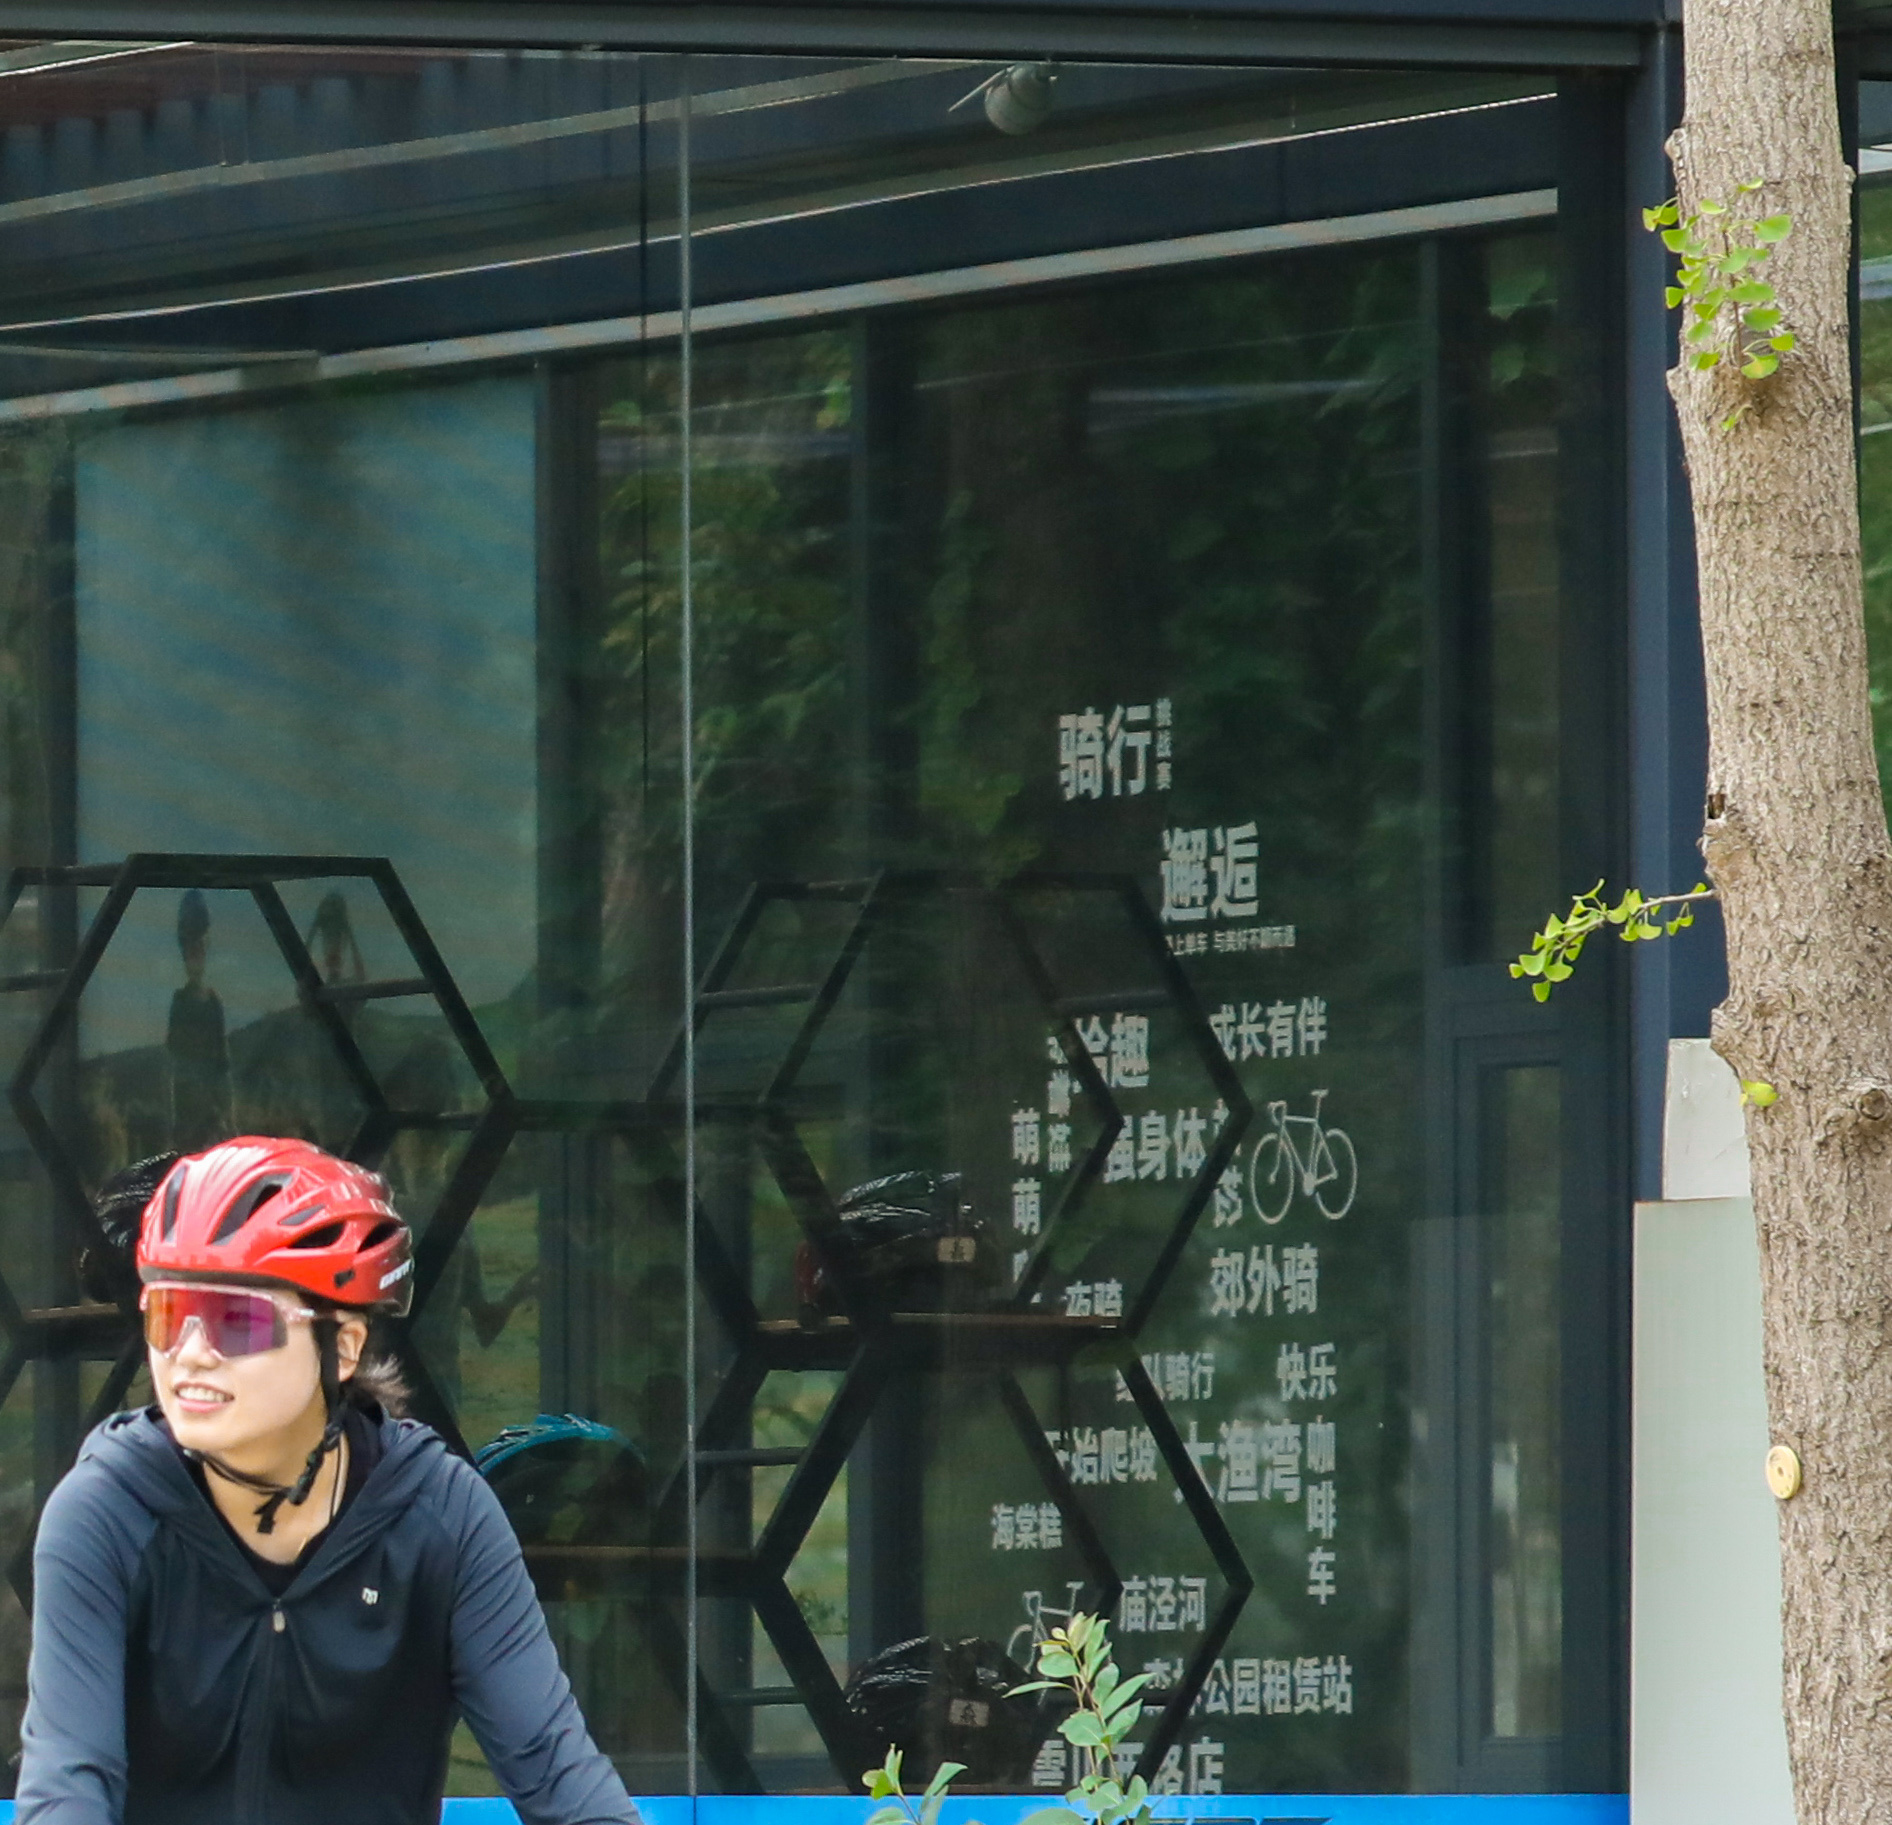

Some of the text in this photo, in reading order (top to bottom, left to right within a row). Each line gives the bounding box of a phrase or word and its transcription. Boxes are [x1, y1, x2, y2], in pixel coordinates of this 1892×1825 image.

[1059, 703, 1152, 801] 骑行
[1159, 820, 1259, 924] 邂逅
[1209, 995, 1328, 1062] 成长有伴
[1210, 1242, 1319, 1317] 郊外骑
[1276, 1341, 1338, 1402] 快乐
[991, 1501, 1063, 1551] 海棠糕
[1306, 1414, 1338, 1606] 咖啡车
